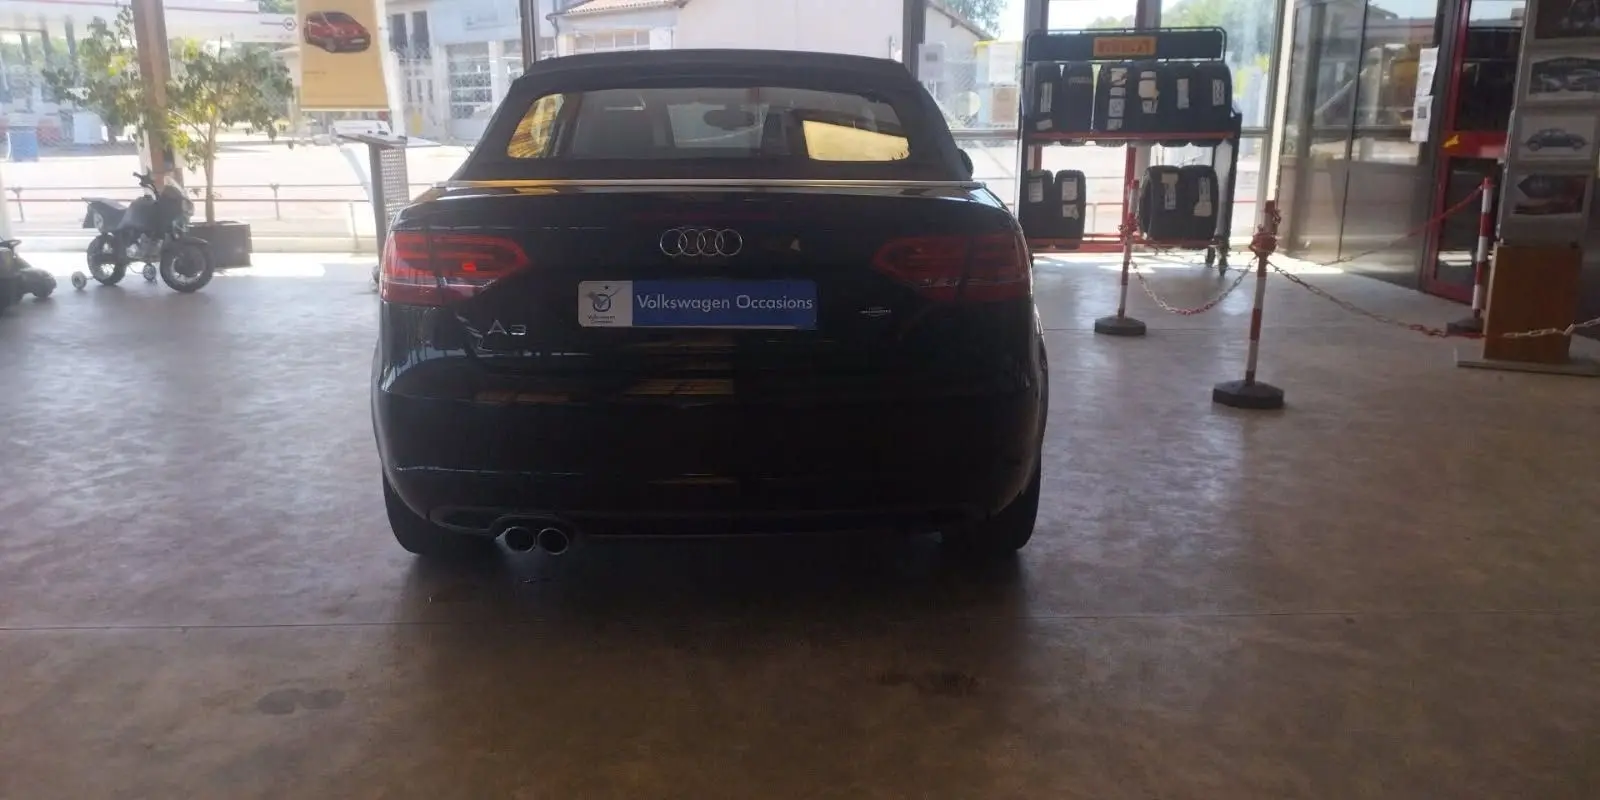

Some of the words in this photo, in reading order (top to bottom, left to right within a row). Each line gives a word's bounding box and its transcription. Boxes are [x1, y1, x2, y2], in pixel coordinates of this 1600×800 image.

[637, 294, 730, 312] Volkswagen
[736, 294, 813, 309] Occasions
[487, 319, 527, 336] A3
